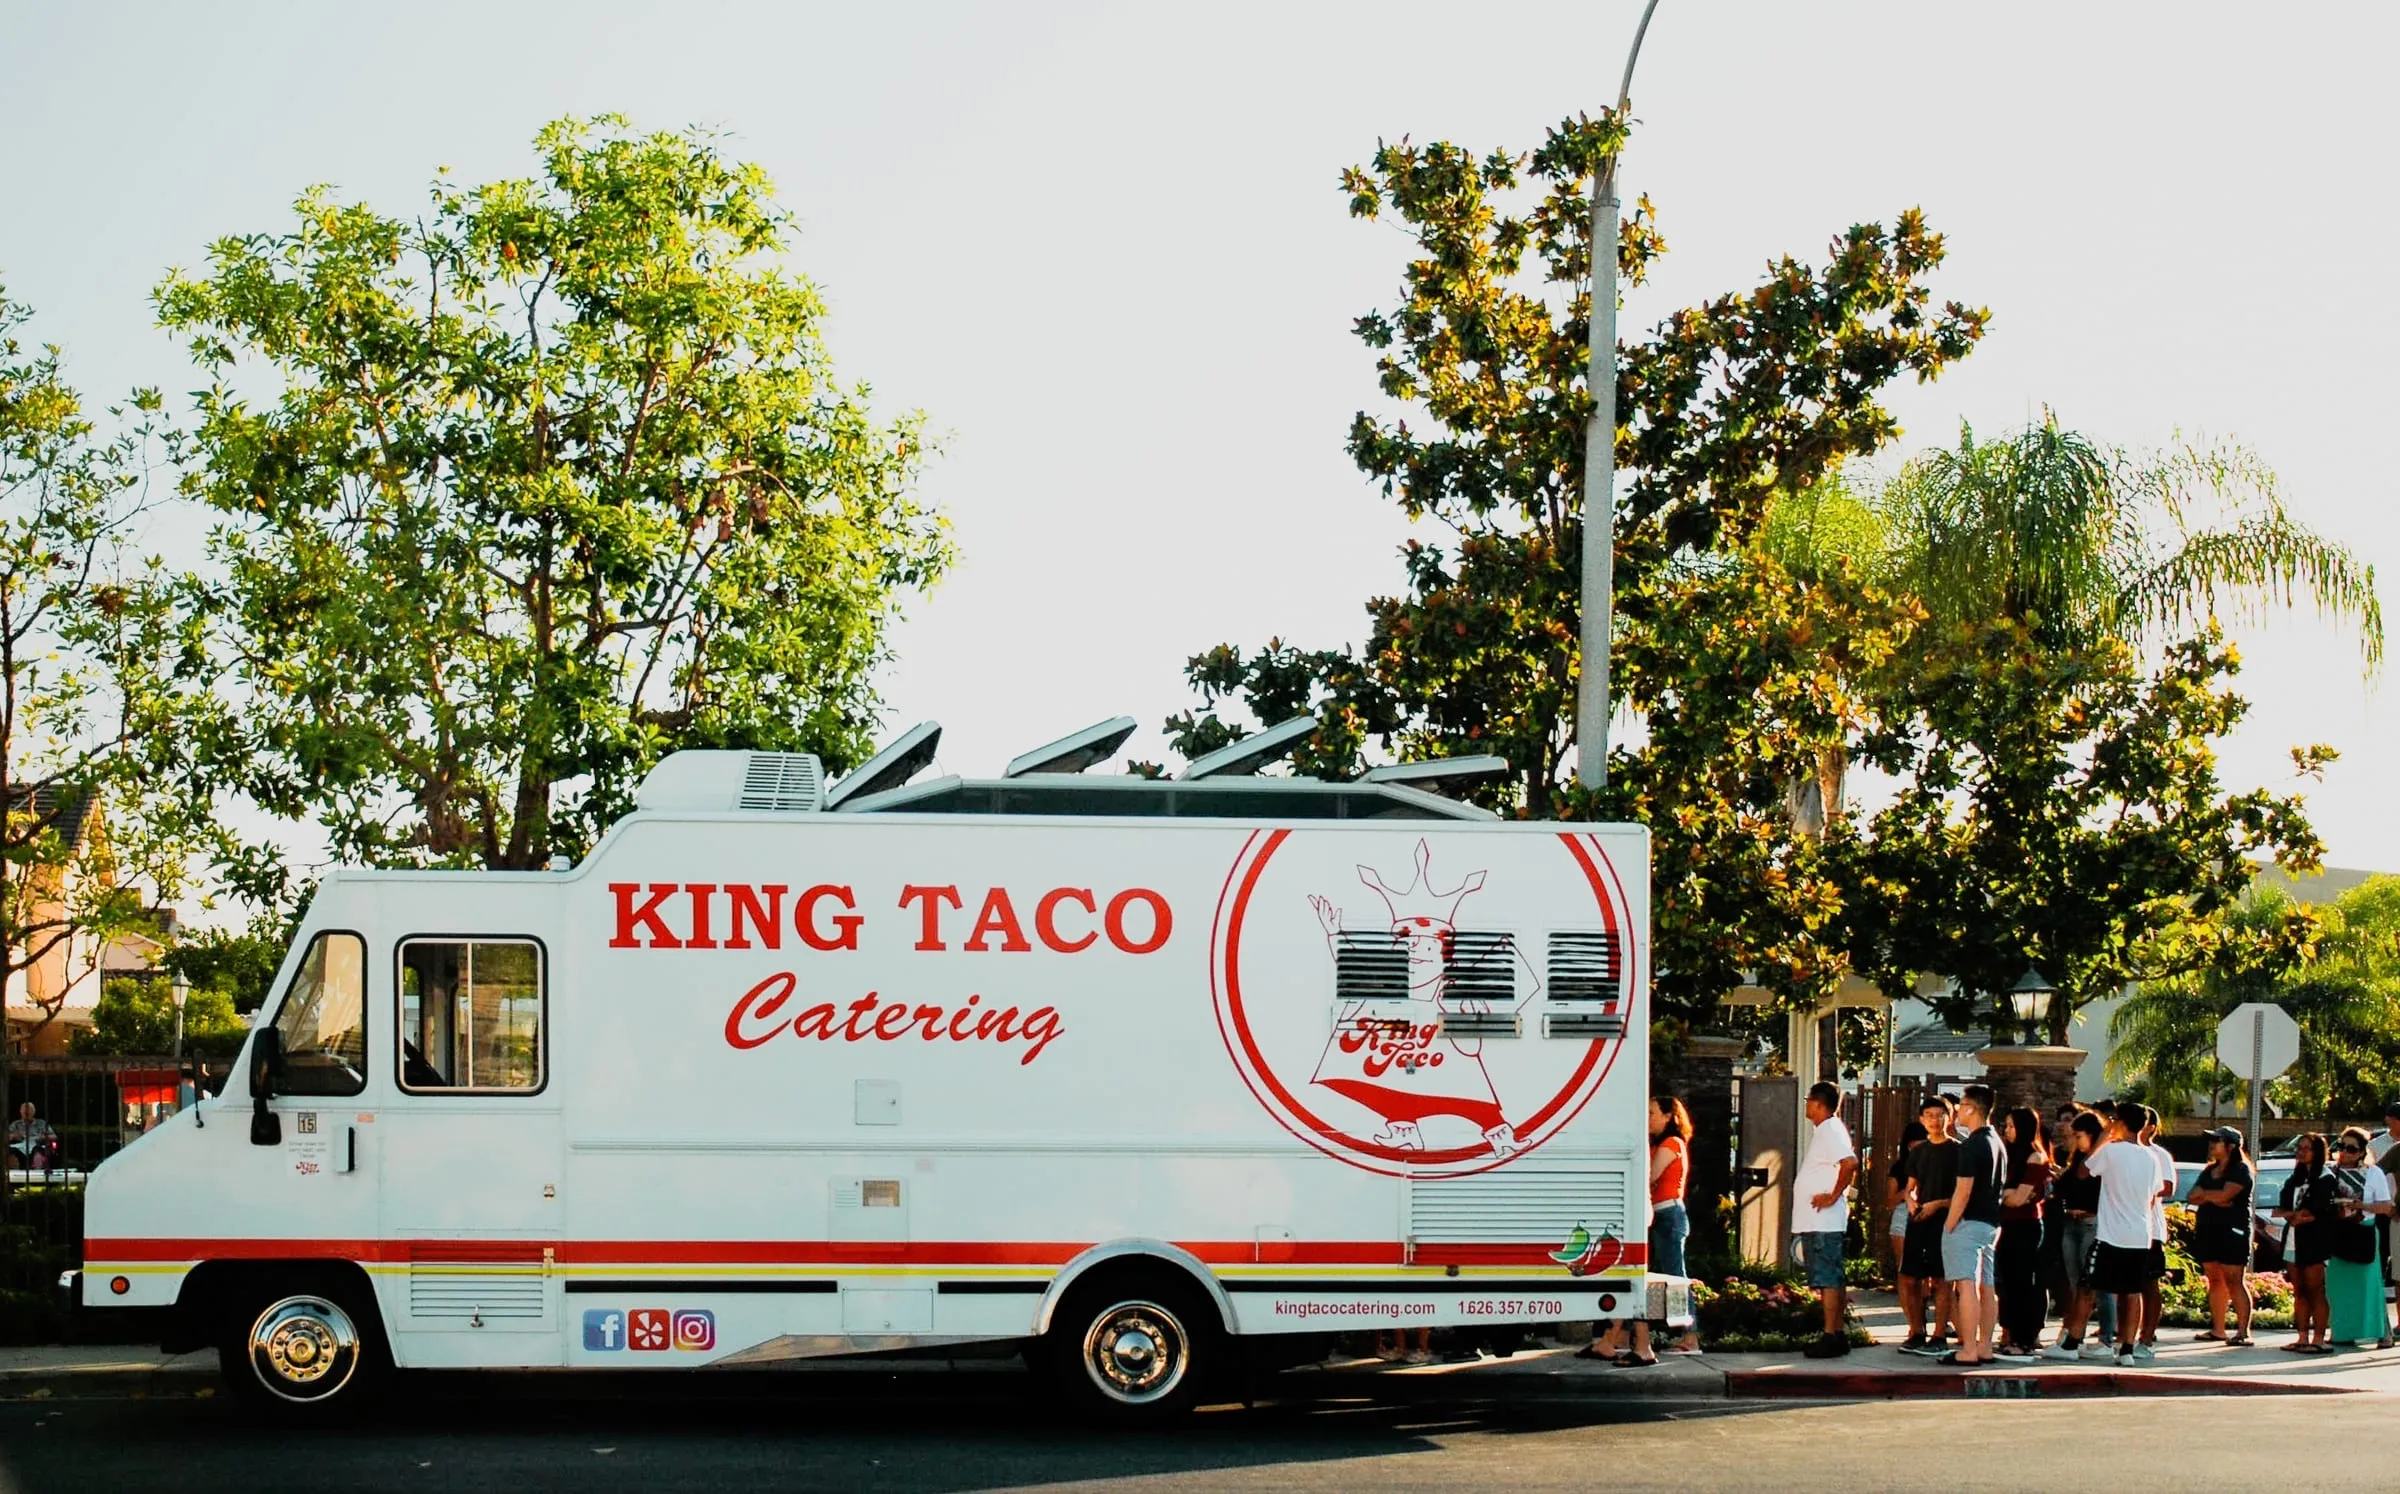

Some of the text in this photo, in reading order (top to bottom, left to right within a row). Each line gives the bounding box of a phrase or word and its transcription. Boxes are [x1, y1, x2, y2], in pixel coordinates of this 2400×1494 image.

[608, 882, 1174, 954] KING TACO
[724, 971, 1065, 1066] Catering
[1362, 1041, 1444, 1078] Taco
[300, 1119, 314, 1131] 15
[1275, 1300, 1436, 1319] kingtacocatering.com
